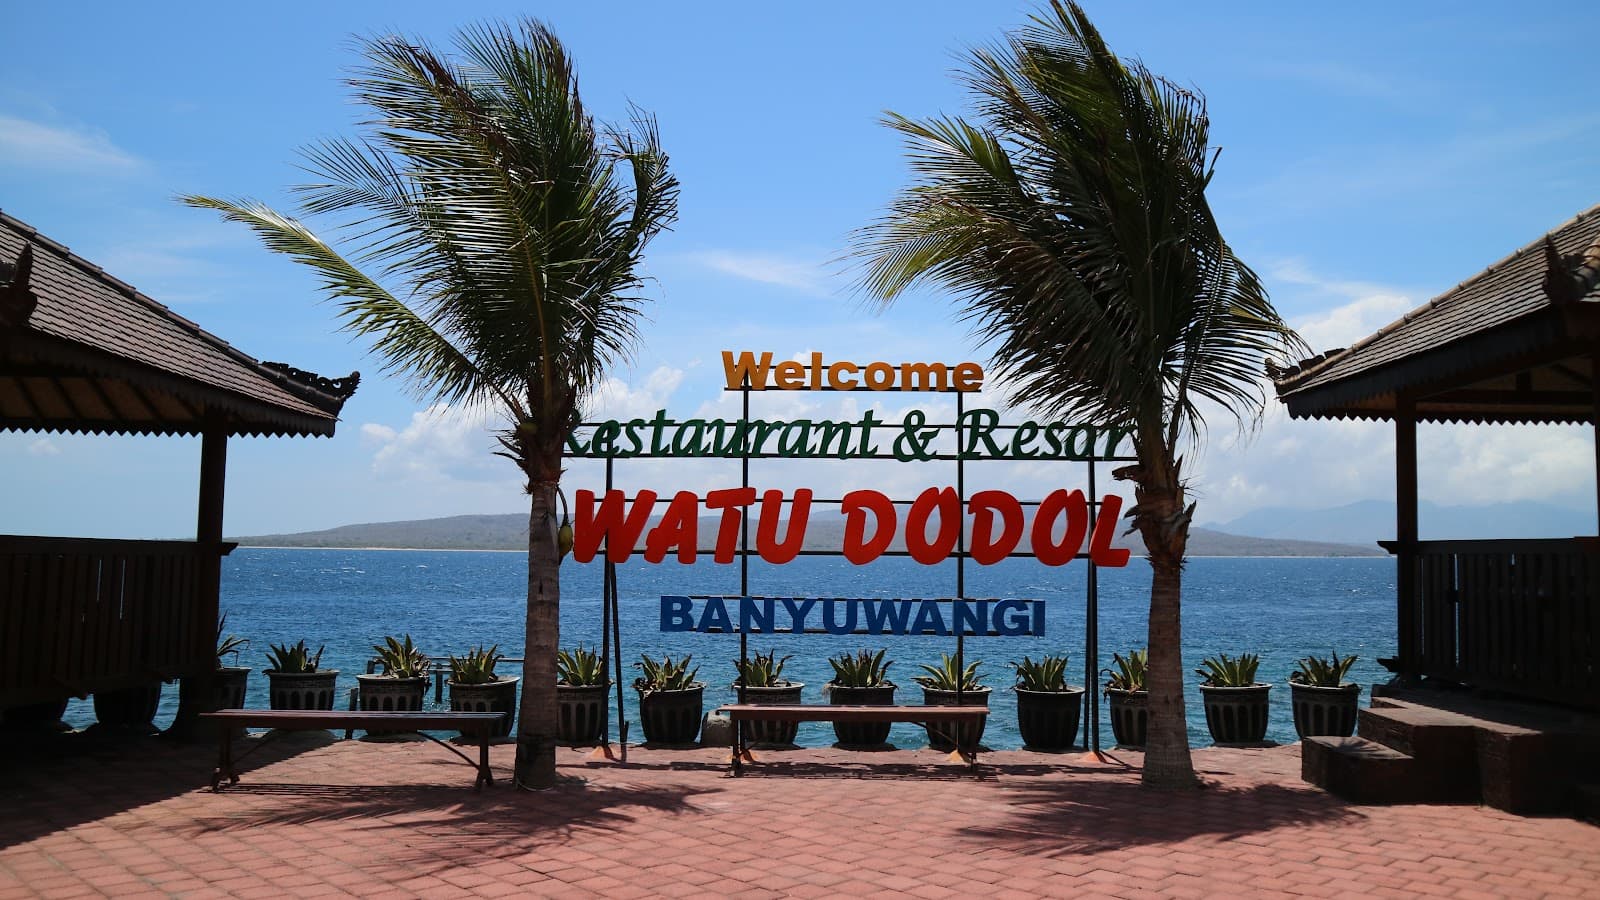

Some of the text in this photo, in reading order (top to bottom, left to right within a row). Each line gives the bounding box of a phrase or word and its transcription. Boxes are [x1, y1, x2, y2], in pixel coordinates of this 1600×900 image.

[721, 351, 984, 391] Welcome
[893, 409, 940, 462] &
[955, 408, 1142, 460] Resor
[573, 486, 1131, 567] WATU DODOL
[660, 595, 1046, 636] BANYUWANGI
